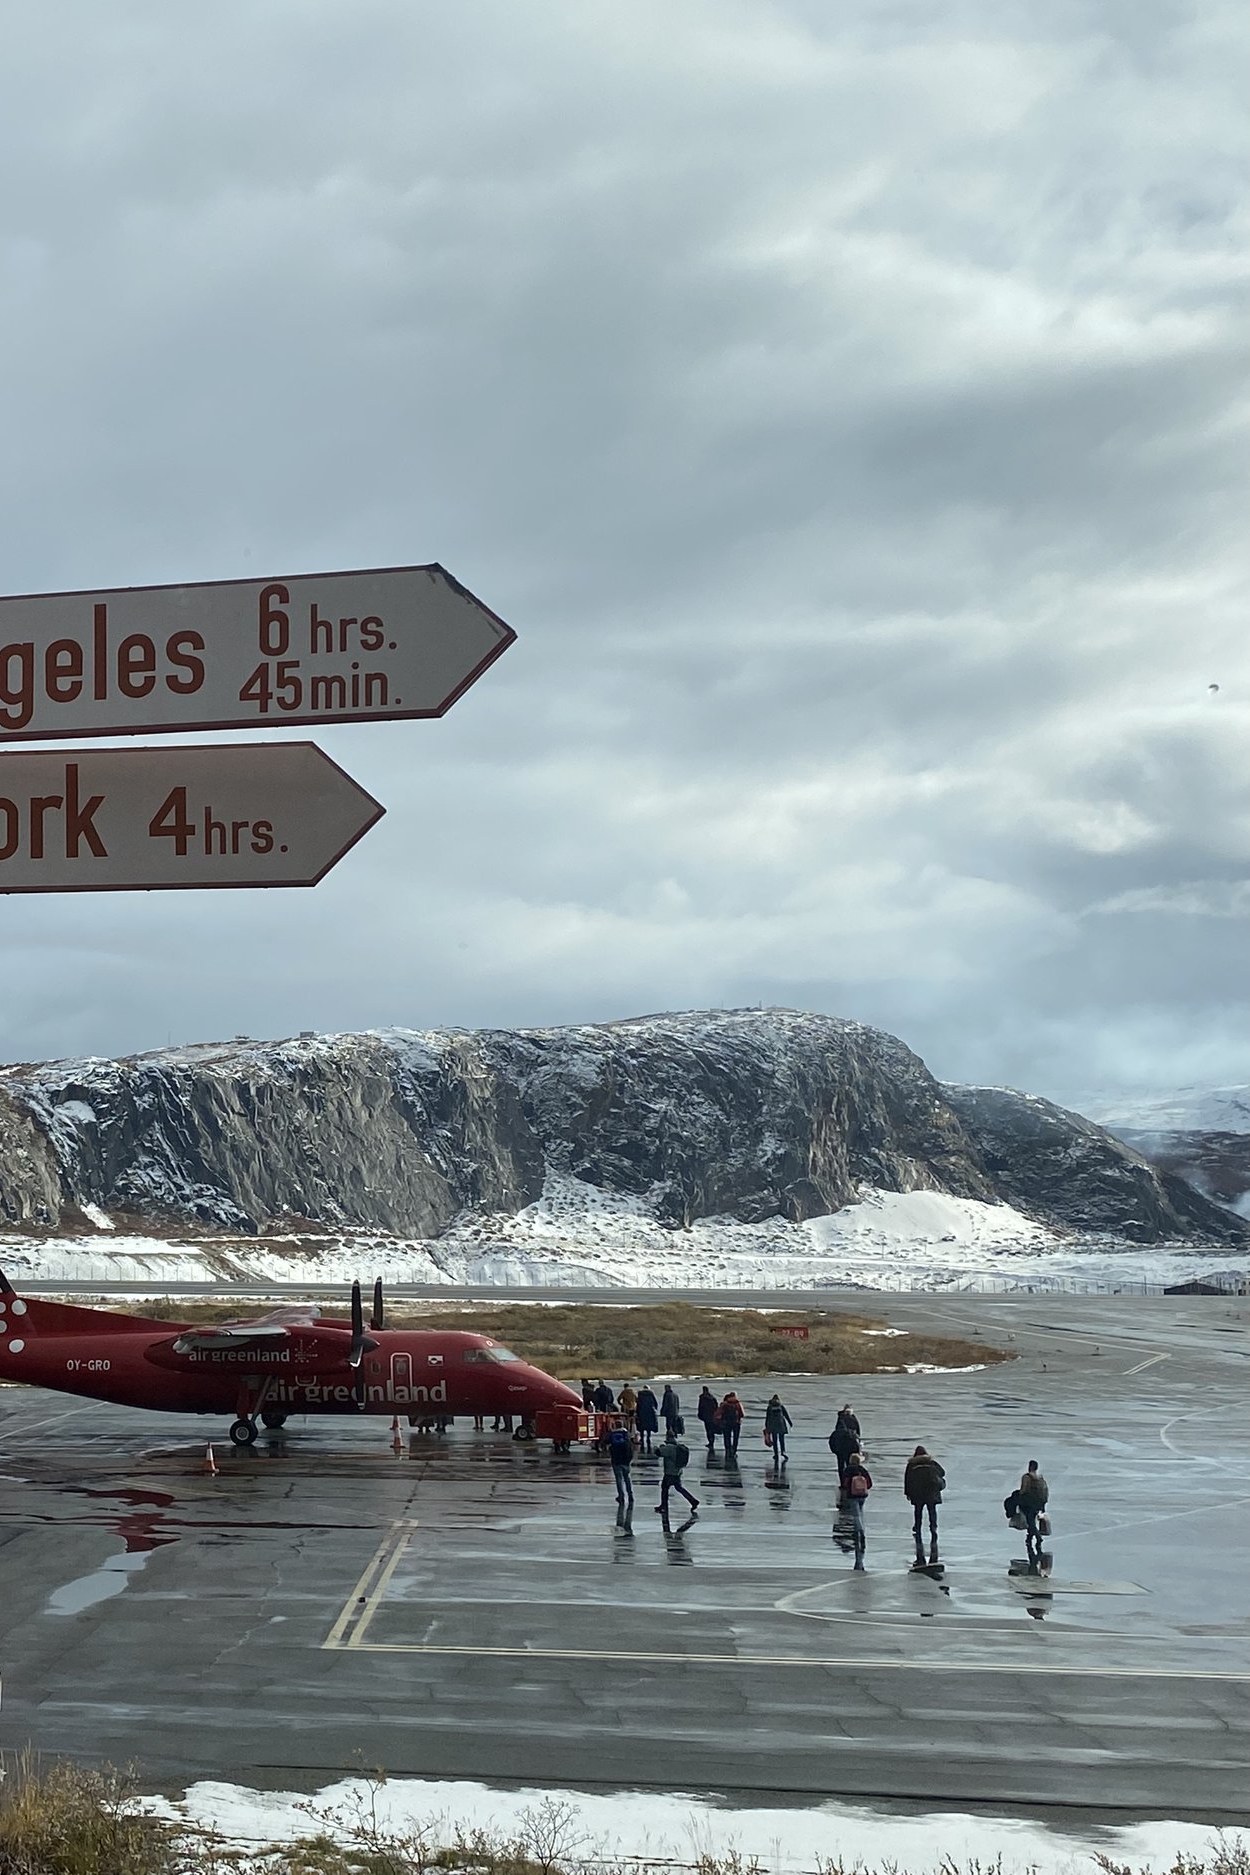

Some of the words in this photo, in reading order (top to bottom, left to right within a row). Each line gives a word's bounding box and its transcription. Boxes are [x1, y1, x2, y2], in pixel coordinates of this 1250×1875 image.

[258, 583, 290, 657] 6
[310, 603, 398, 655] hrs.
[238, 660, 303, 713] 45
[310, 661, 402, 710] min.
[148, 786, 196, 856] 4
[203, 805, 289, 855] hrs.
[66, 1359, 111, 1371] OY-GRO
[189, 1348, 209, 1361] air
[211, 1348, 290, 1362] greenland
